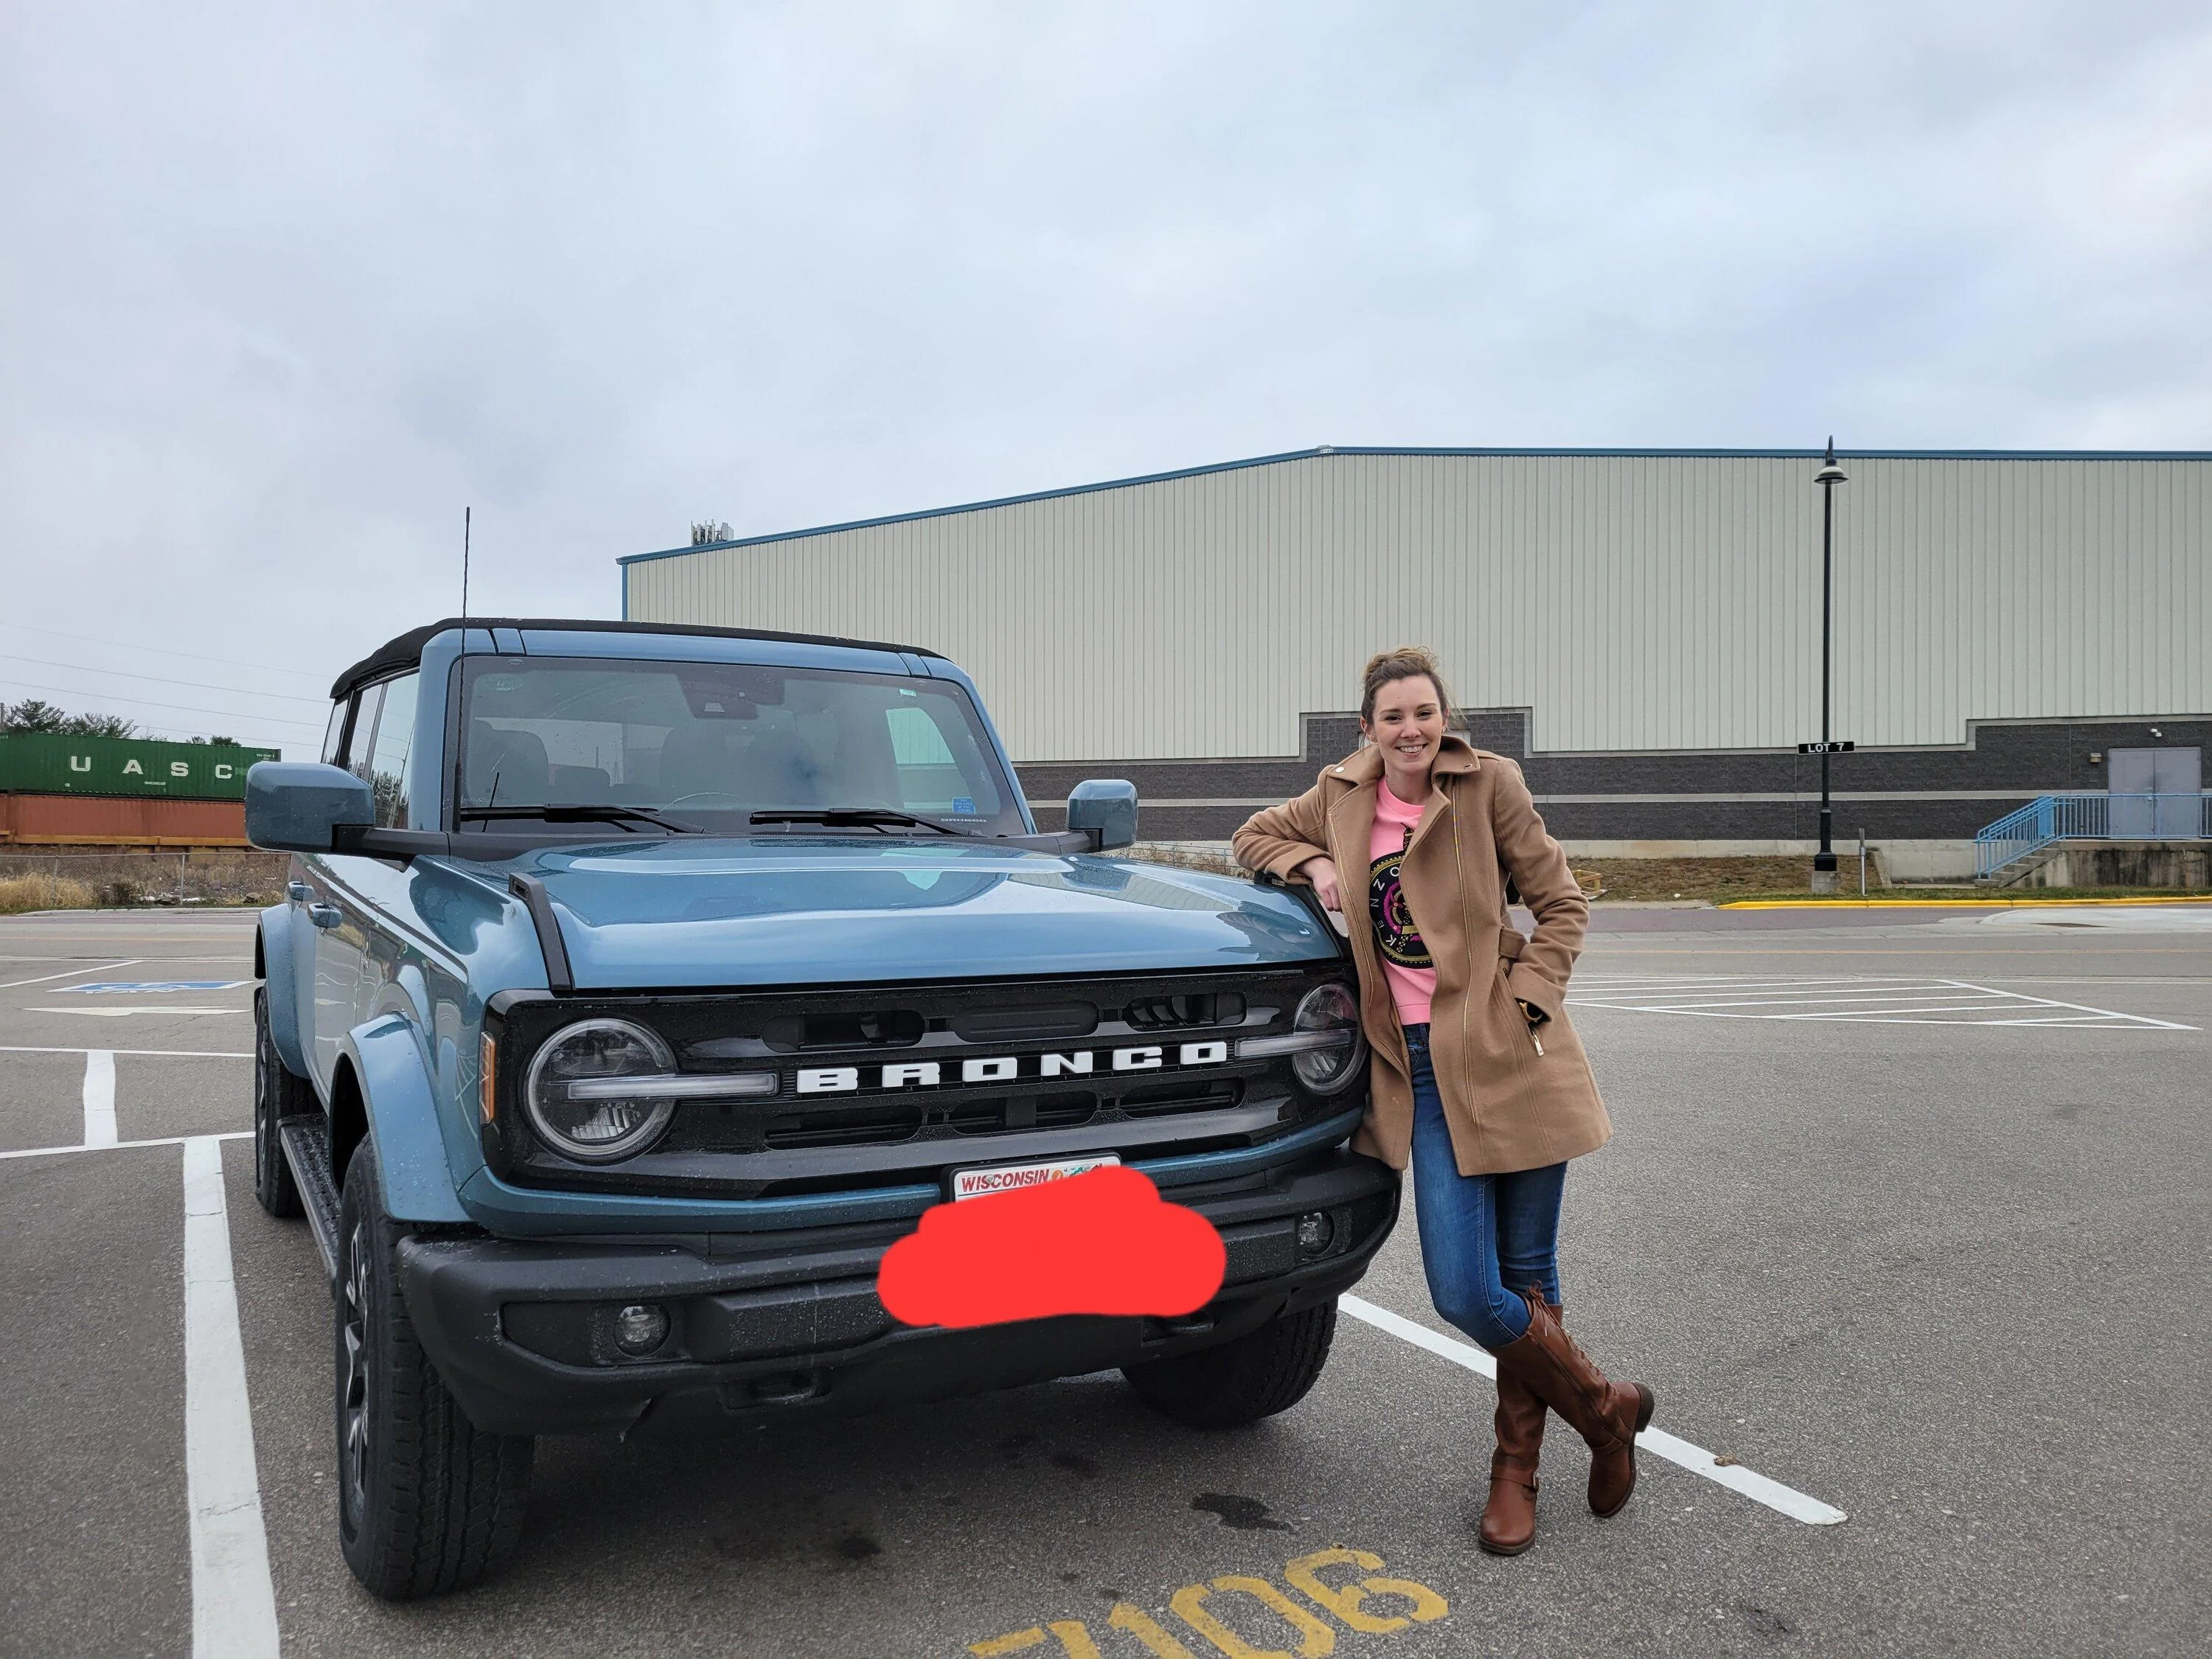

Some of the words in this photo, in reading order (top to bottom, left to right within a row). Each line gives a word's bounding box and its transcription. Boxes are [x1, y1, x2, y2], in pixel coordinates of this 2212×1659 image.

[1808, 743, 1830, 753] LOT
[1837, 742, 1844, 751] 7
[797, 1041, 1227, 1093] BRONCO
[961, 1169, 1050, 1192] WISCONSIN
